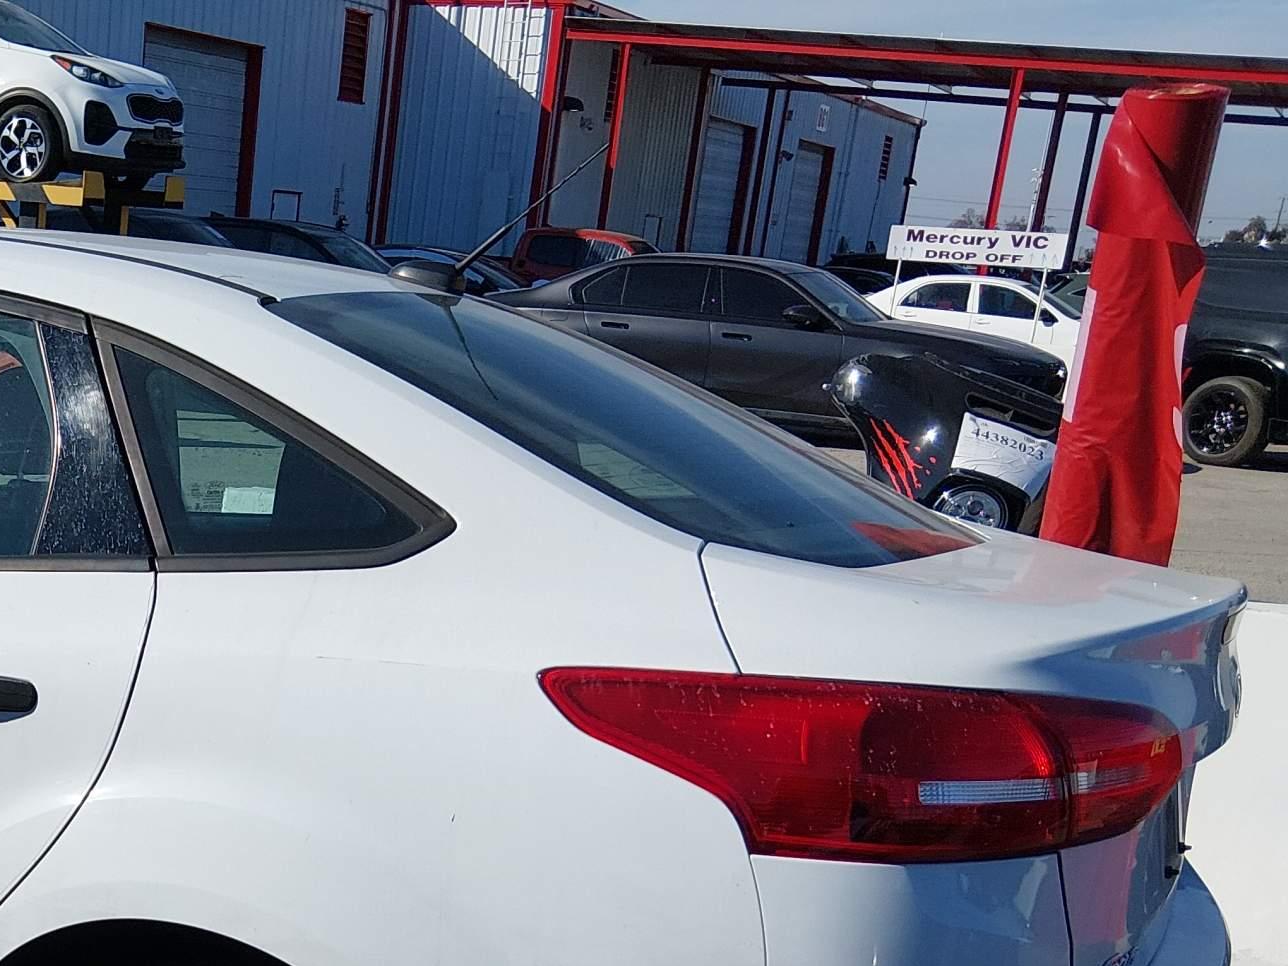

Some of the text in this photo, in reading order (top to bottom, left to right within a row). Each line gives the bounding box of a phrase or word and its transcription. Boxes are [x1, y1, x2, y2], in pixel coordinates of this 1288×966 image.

[906, 229, 1049, 249] Mercury VIC
[925, 250, 1024, 263] DROP OFF
[971, 427, 1044, 461] 44382023
